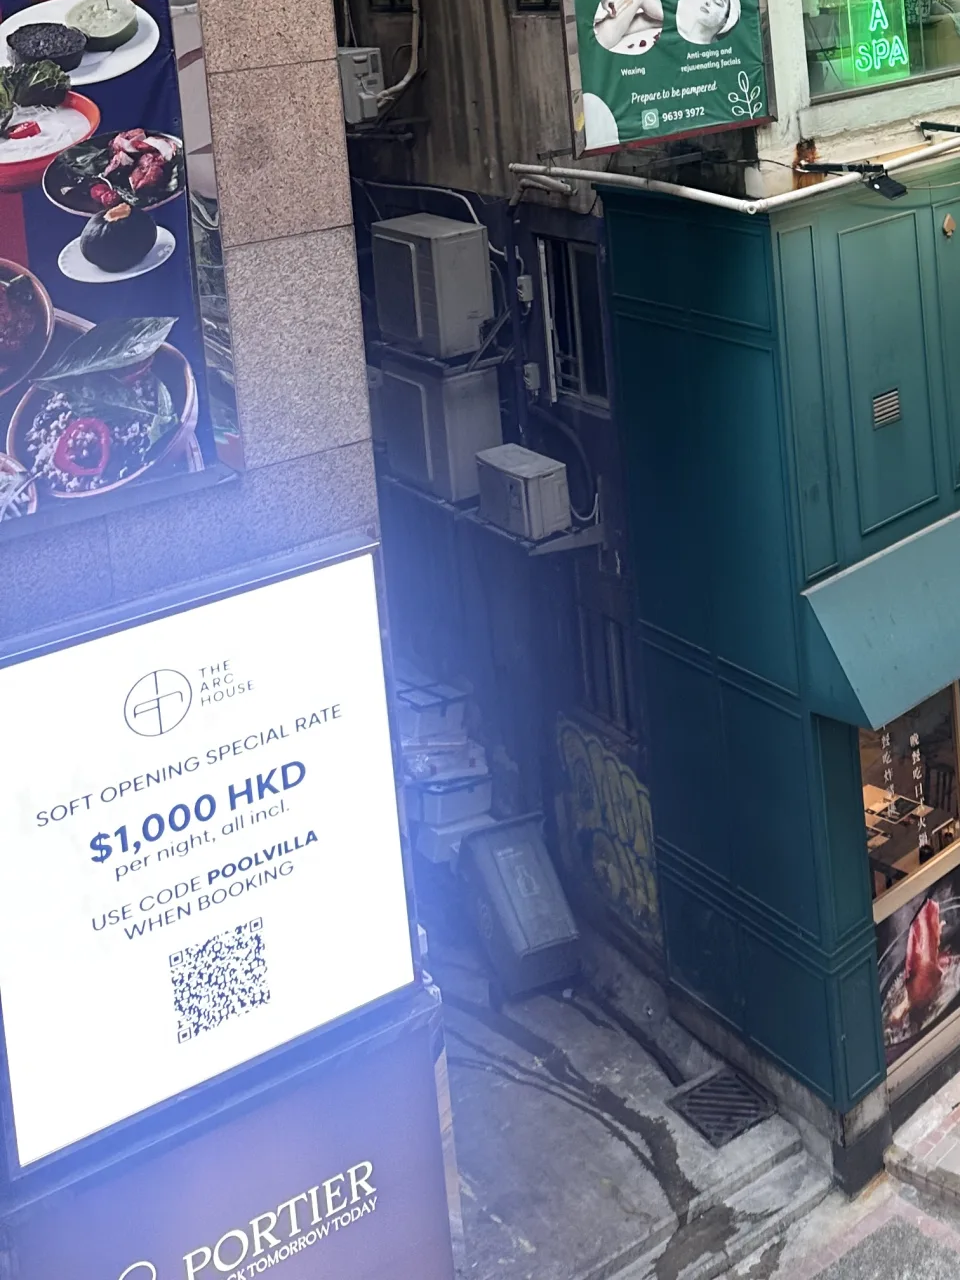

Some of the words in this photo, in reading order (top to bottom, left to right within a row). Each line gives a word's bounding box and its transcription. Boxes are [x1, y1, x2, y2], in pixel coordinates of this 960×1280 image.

[681, 60, 720, 73] rejuvenating
[720, 57, 741, 69] facials
[687, 50, 719, 60] Anti-aging
[720, 46, 732, 55] and
[854, 35, 909, 73] SPA
[621, 66, 646, 76] Waxing
[631, 92, 662, 105] Prepare
[662, 89, 670, 99] to
[671, 87, 680, 98] be
[681, 80, 717, 98] pampered
[662, 110, 683, 122] 9639
[685, 106, 705, 118] 3972
[198, 659, 231, 679] THE
[200, 673, 235, 693] ARC
[200, 679, 255, 707] HOUSE
[36, 794, 93, 827] SOFT
[99, 756, 200, 803] OPENING
[205, 725, 290, 765] SPECIAL
[295, 703, 343, 733] RATE
[89, 793, 217, 863] $1,000
[227, 760, 307, 811] HKD
[115, 854, 151, 882] per
[157, 829, 216, 862] night,
[221, 814, 244, 836] all
[250, 799, 290, 825] incl.
[92, 903, 133, 931] USE
[139, 875, 202, 912] CODE
[207, 830, 318, 885] POOLVILLA
[124, 902, 191, 940] WHEN
[198, 860, 295, 911] BOOKING
[182, 1160, 377, 1280] PORTIER
[246, 1222, 330, 1277] TOMORROW
[331, 1196, 378, 1232] TODAY
